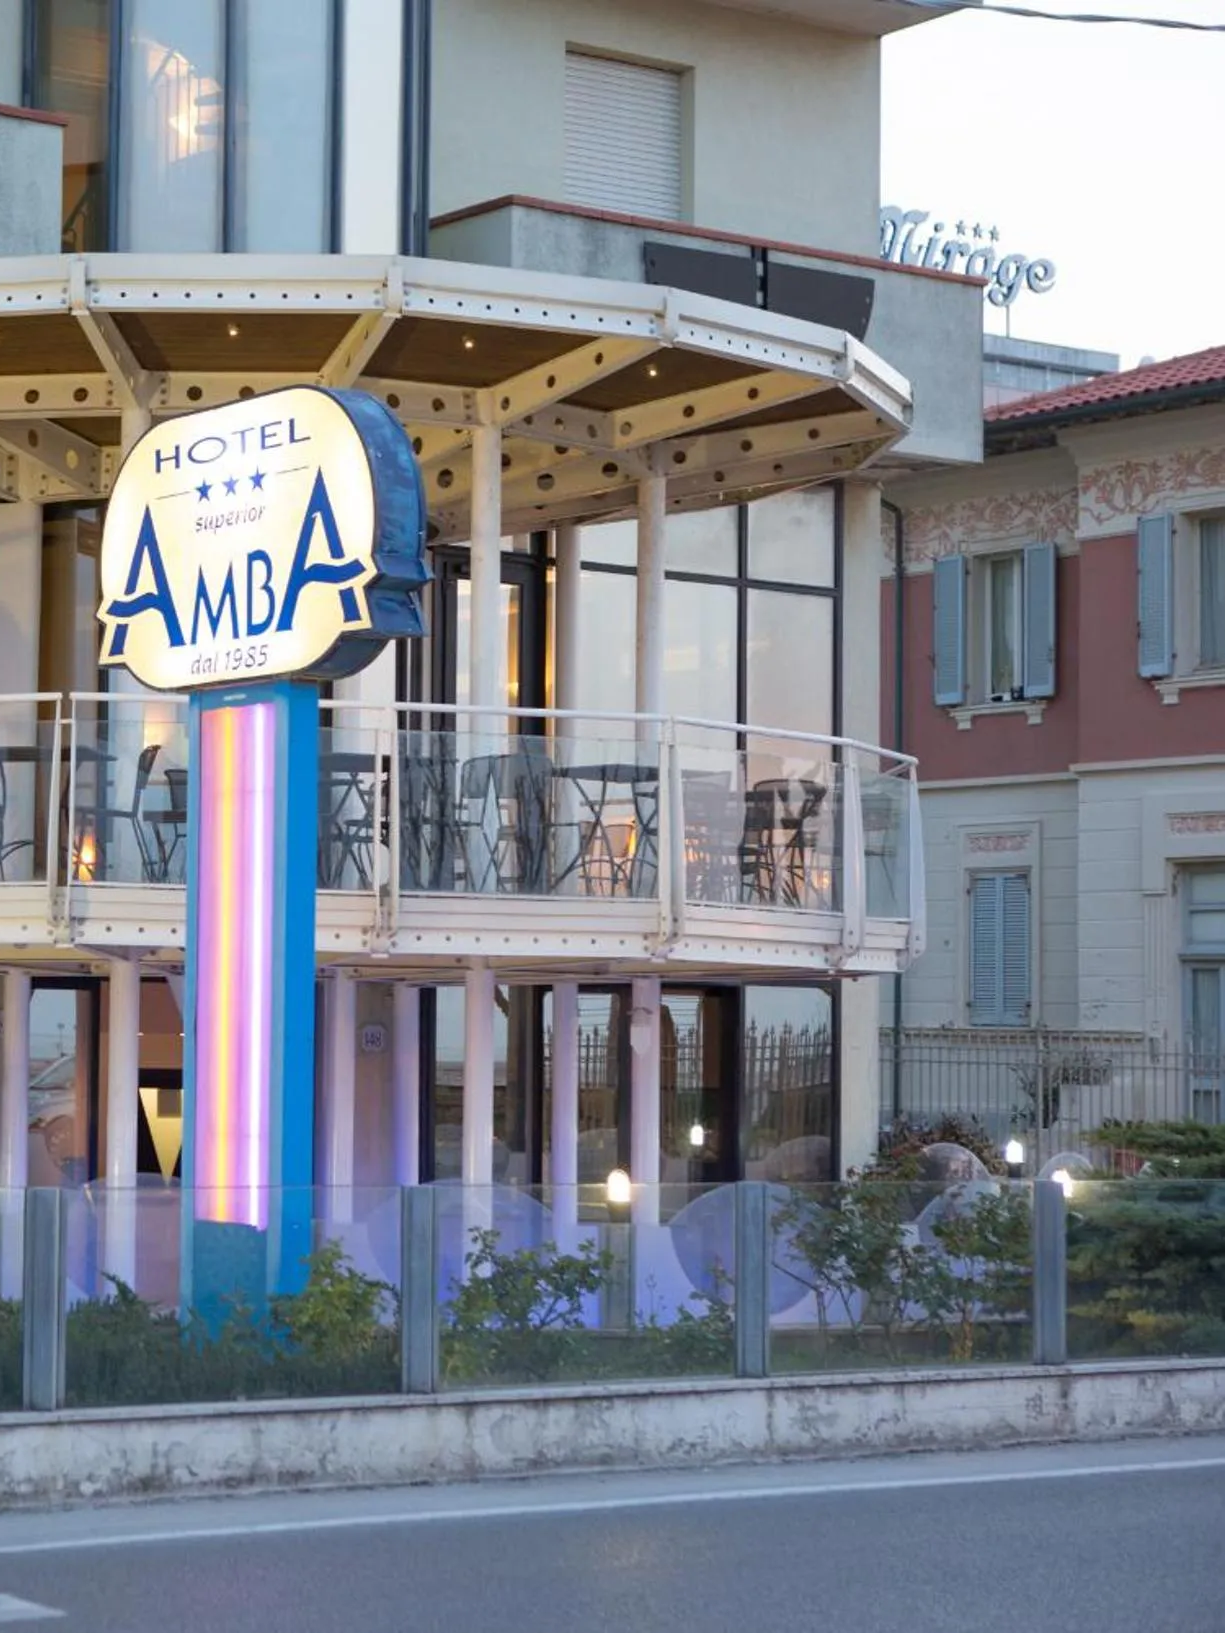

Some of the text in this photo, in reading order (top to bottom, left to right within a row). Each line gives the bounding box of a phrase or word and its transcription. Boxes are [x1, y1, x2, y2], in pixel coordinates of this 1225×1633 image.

[880, 205, 1056, 307] Mirage
[154, 417, 312, 474] HOTEL
[194, 504, 266, 534] superior
[106, 466, 367, 657] AMBA
[190, 644, 270, 676] dal 1985
